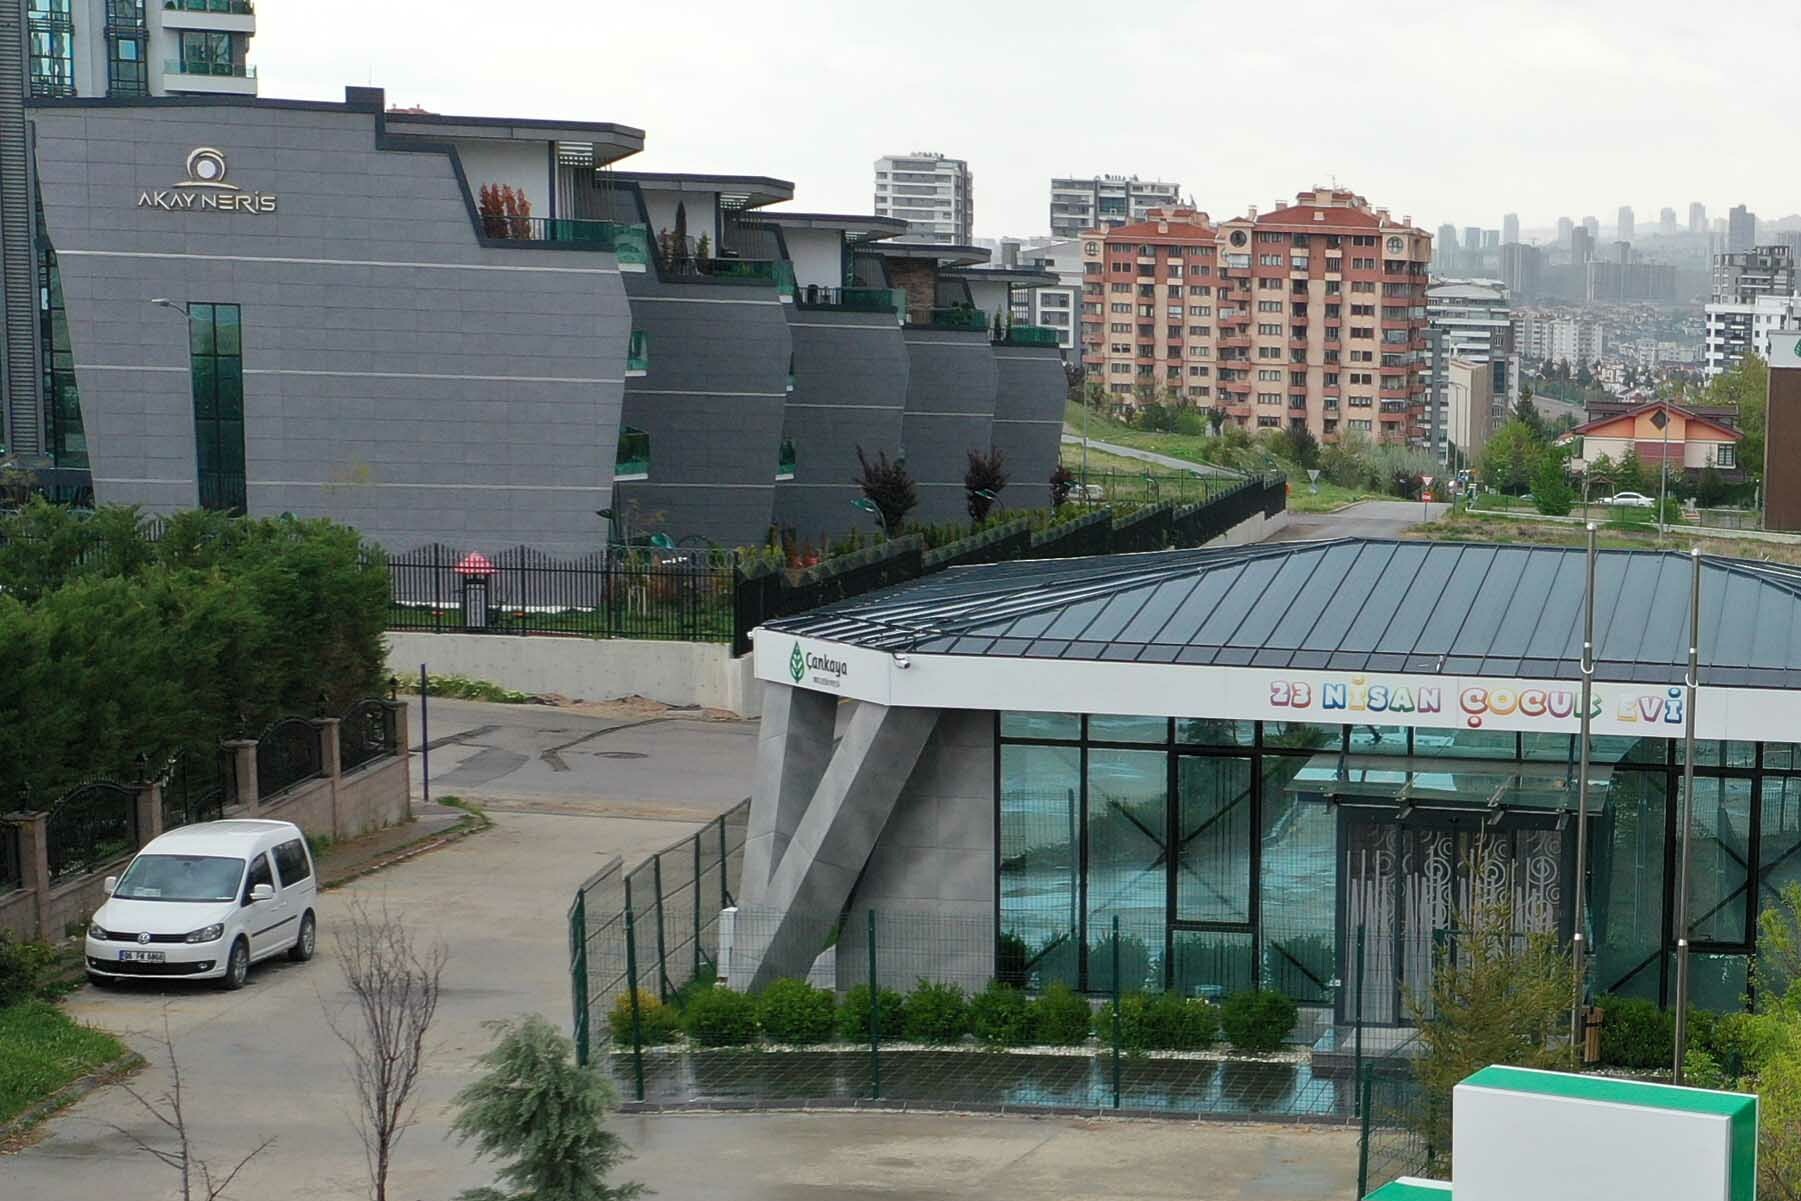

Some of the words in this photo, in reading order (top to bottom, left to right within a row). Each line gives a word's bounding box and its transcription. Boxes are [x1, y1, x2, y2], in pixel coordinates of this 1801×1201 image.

[138, 191, 195, 210] AKAY
[201, 190, 276, 214] NERİS
[806, 651, 848, 677] Çankaya
[1270, 681, 1312, 709] 23
[1322, 674, 1441, 713] NİSAN
[1460, 687, 1602, 728] ÇOCUK
[1616, 687, 1683, 724] EVİ
